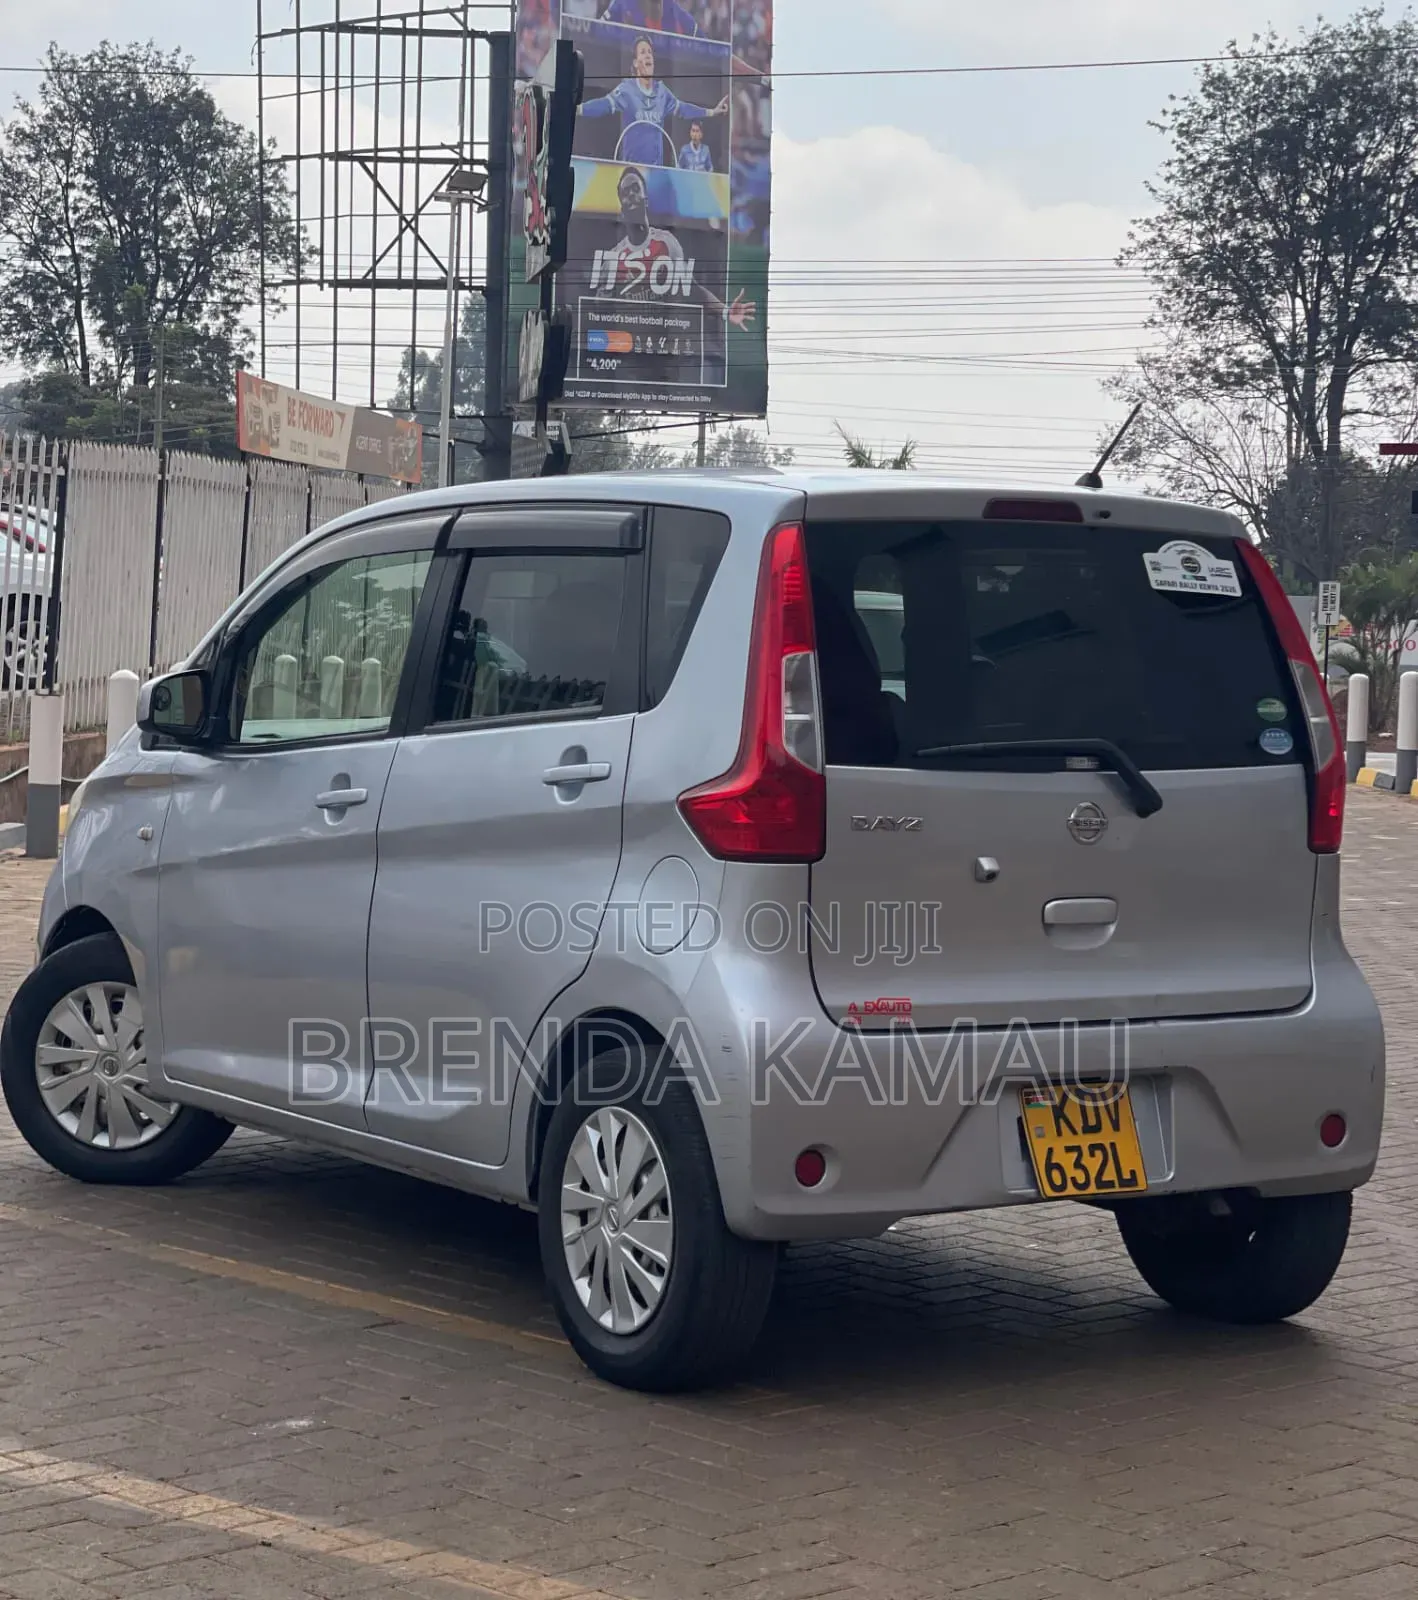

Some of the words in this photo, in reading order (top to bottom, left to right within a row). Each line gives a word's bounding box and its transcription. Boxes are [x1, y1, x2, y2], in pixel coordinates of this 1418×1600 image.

[650, 255, 696, 297] ON
[588, 312, 600, 321] The
[600, 312, 625, 323] world's
[624, 314, 638, 324] best
[639, 315, 663, 326] football
[664, 318, 690, 330] package
[287, 397, 296, 427] BE
[299, 401, 335, 438] FORWARD
[1155, 579, 1177, 588] SAFARI
[1179, 581, 1197, 589] RALLY
[1199, 582, 1219, 591] KENYA
[851, 815, 923, 831] DAYZ
[1050, 1084, 1124, 1137] KDV
[1044, 1142, 1138, 1193] 632L
